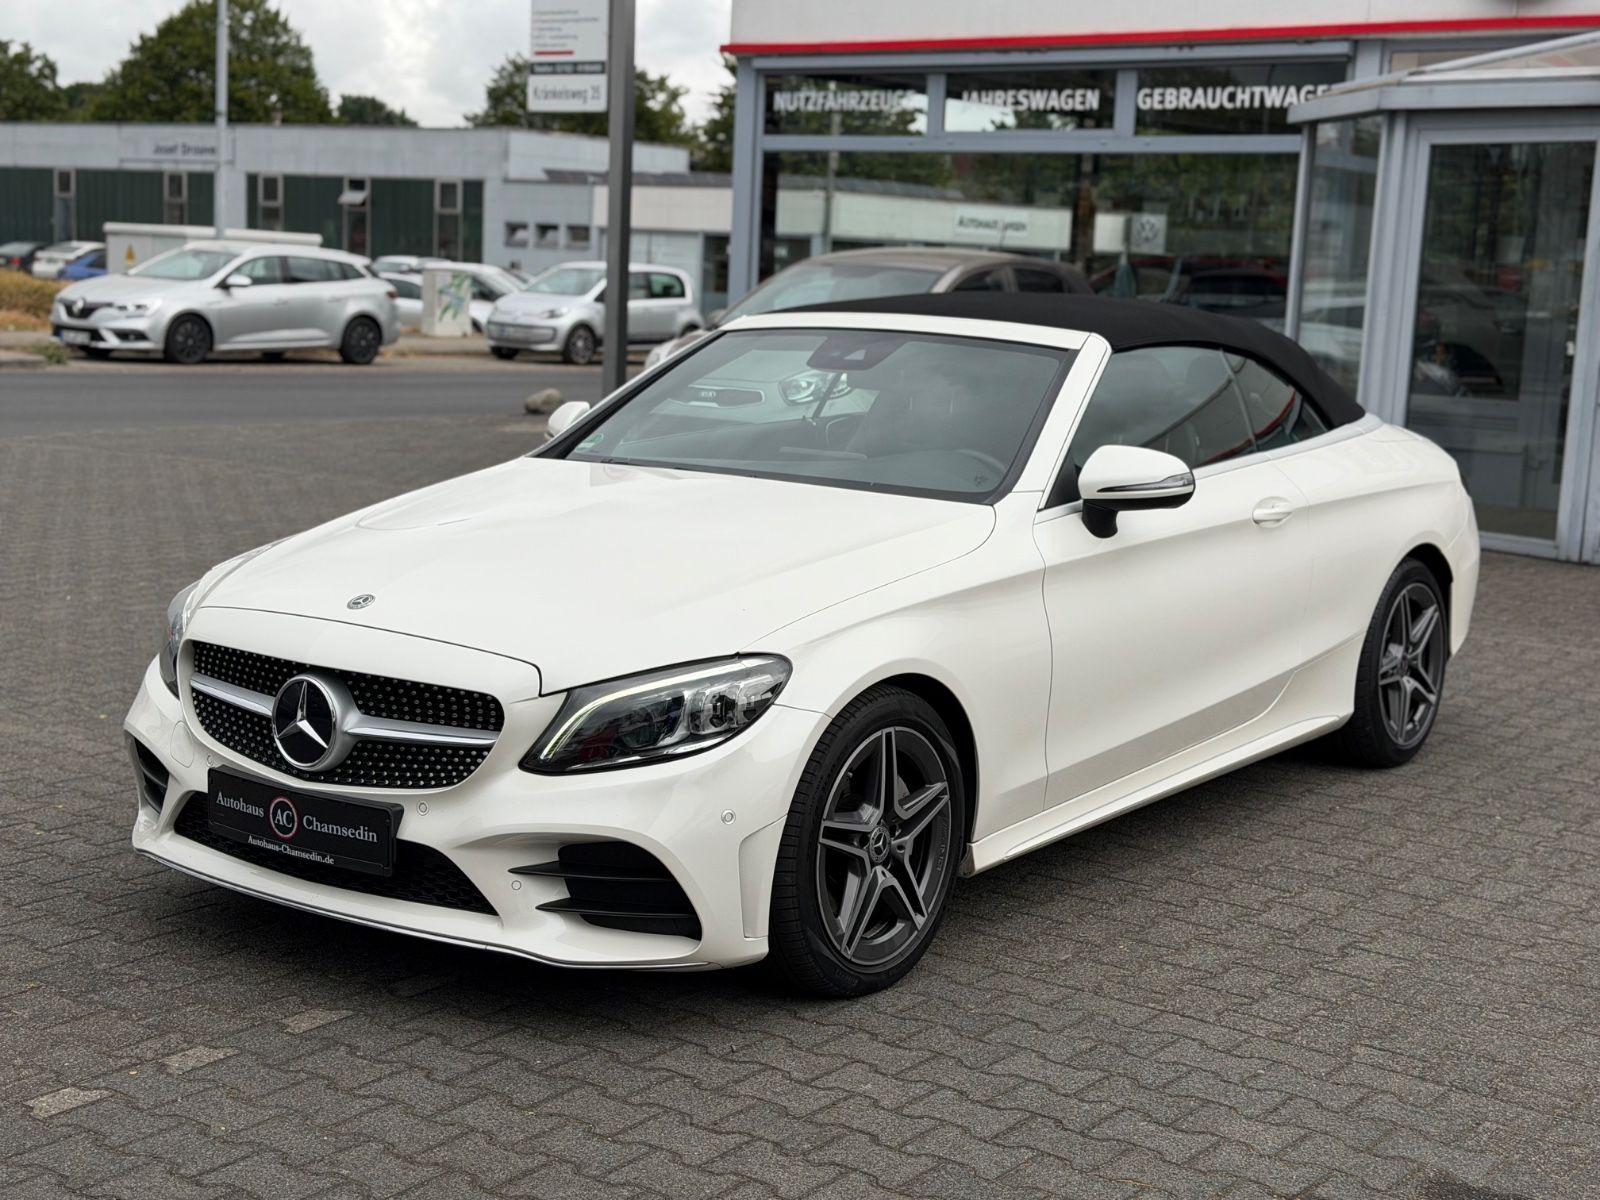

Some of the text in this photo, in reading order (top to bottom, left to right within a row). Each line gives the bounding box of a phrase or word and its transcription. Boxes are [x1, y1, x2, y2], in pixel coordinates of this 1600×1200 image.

[962, 88, 1100, 112] JAHRESWAGEN
[215, 790, 378, 842] Autohaus AC Chamsedin
[247, 834, 335, 865] Autohaus-Chamsedin.de
